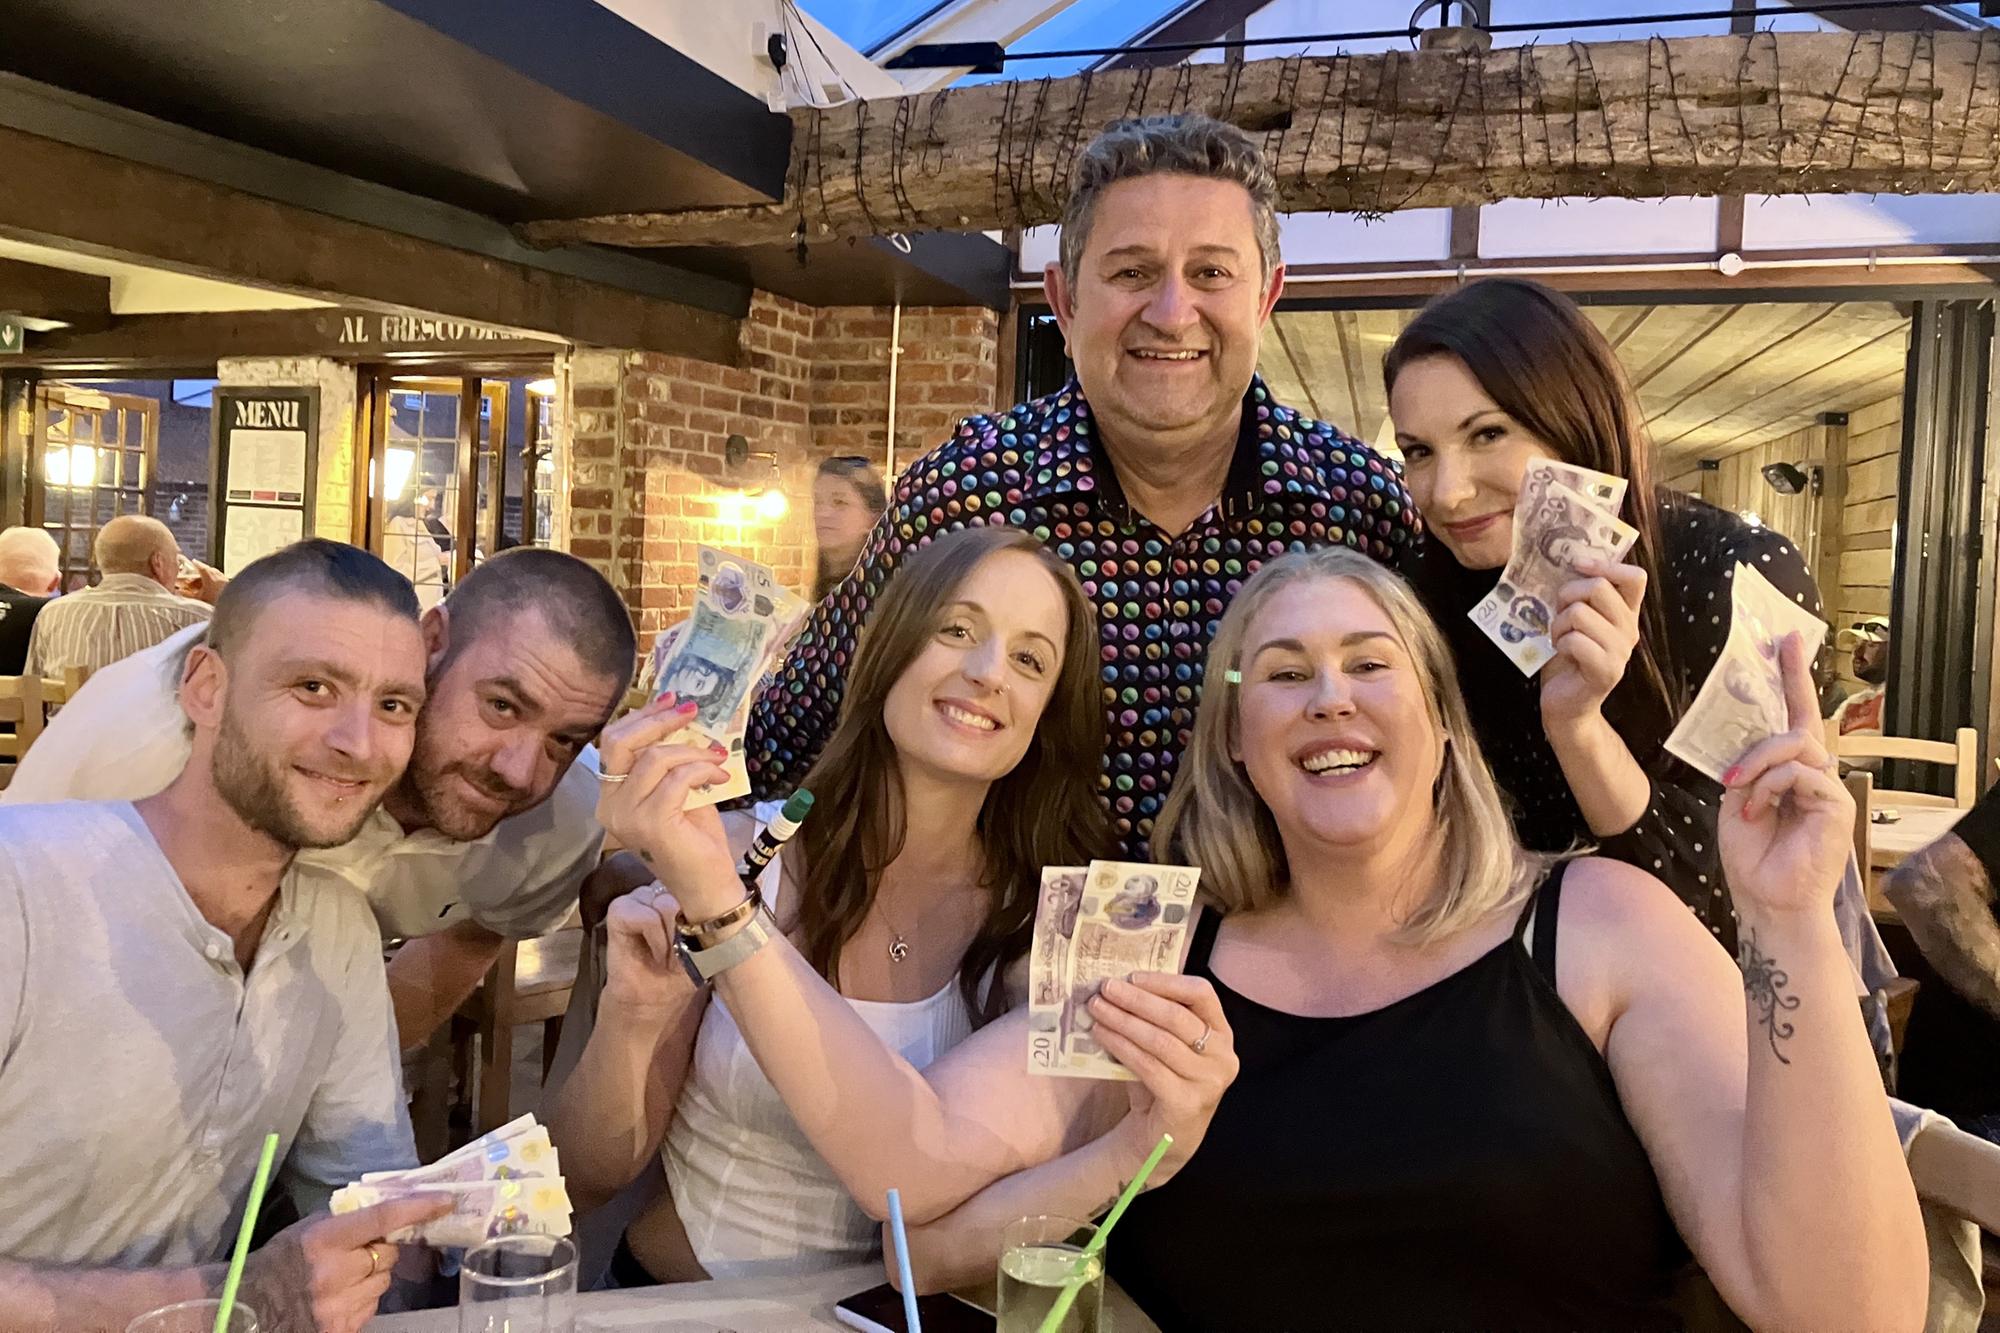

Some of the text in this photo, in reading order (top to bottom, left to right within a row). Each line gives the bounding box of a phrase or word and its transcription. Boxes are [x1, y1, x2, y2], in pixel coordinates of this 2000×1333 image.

[339, 316, 368, 343] AL
[381, 315, 464, 342] FRESCO
[235, 400, 299, 428] MENU
